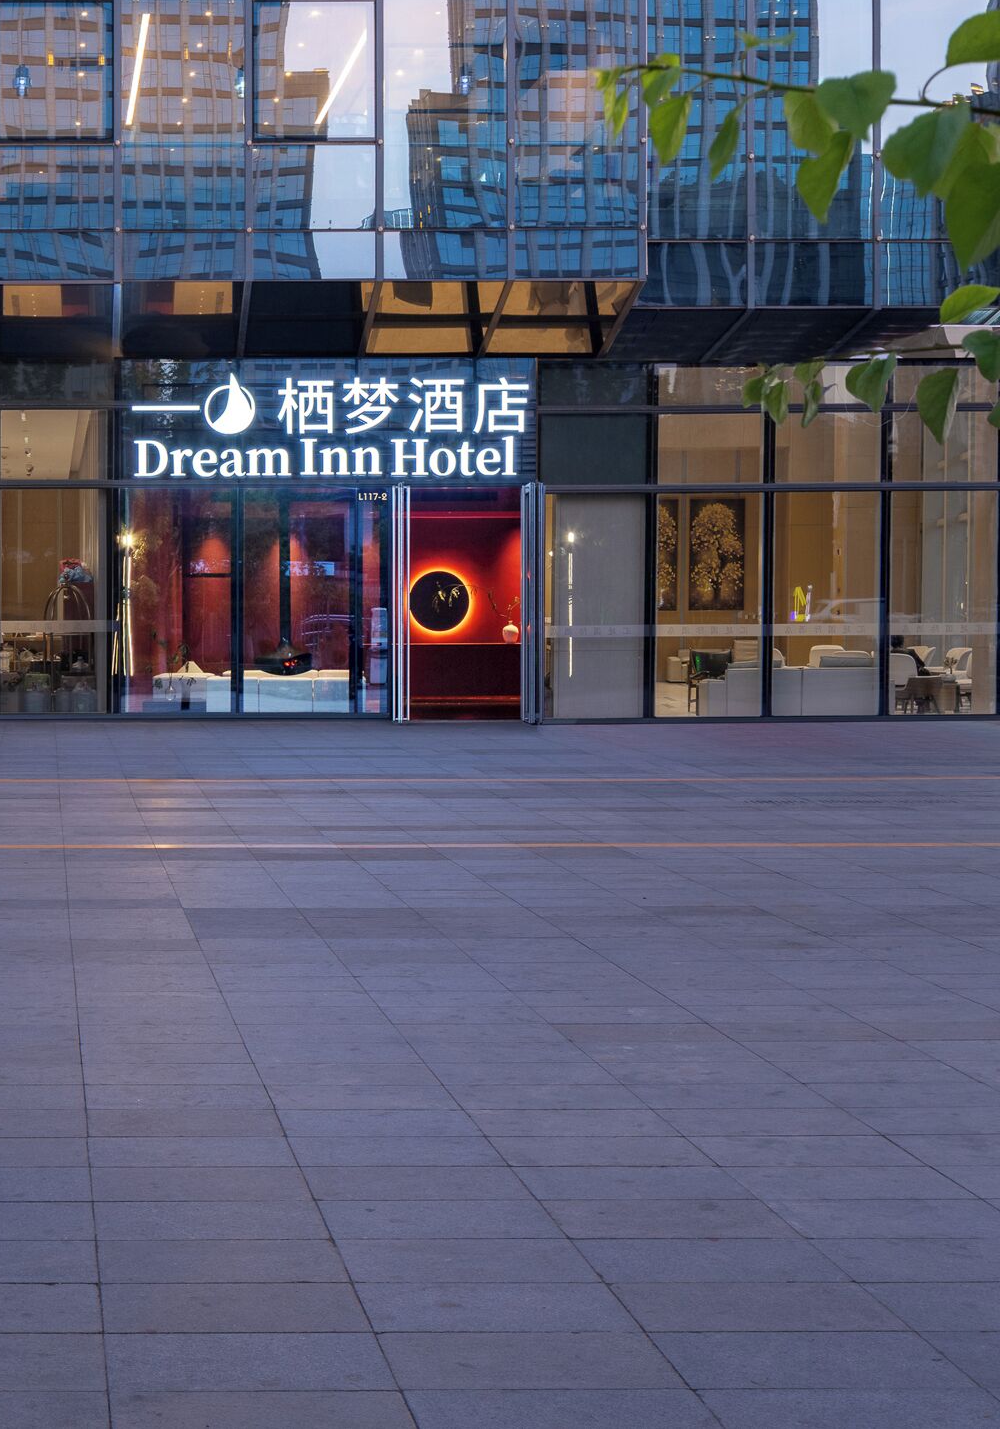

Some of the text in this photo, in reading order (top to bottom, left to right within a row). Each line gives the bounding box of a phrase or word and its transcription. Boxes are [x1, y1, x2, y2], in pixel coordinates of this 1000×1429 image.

[277, 377, 529, 435] 栖梦酒店
[133, 435, 517, 477] Dream Inn Hotel
[358, 492, 388, 501] L117-2
